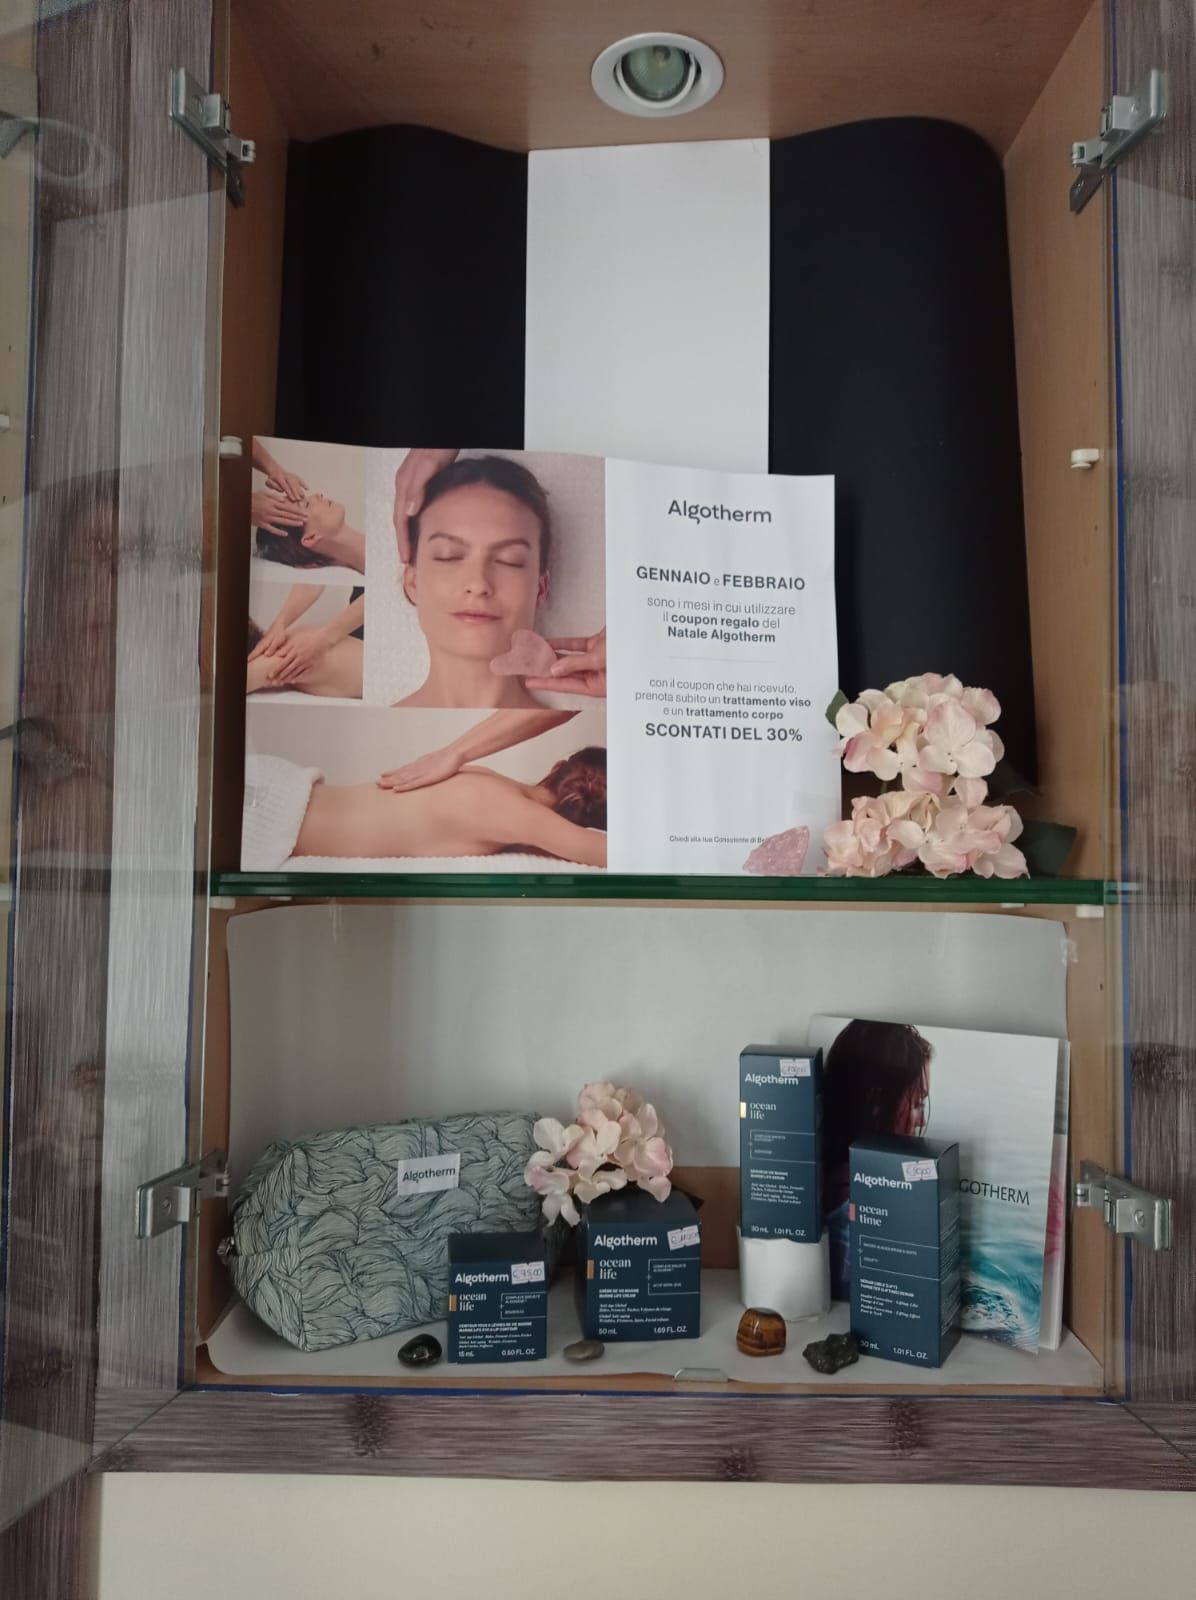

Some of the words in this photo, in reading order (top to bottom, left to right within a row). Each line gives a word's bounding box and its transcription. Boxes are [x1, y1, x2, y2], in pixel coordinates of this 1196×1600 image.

[668, 500, 772, 525] Algotherm
[636, 566, 711, 585] GENNAIO
[714, 578, 720, 586] e
[723, 574, 805, 591] FEBBRAIO
[647, 597, 675, 608] sono
[683, 599, 710, 611] mesi
[713, 601, 723, 612] in
[725, 602, 741, 613] cui
[744, 603, 796, 616] utilizzare
[663, 612, 668, 622] il
[671, 614, 718, 629] coupon
[721, 615, 760, 630] regalo
[762, 617, 780, 629] del
[668, 626, 708, 639] Natale
[711, 628, 776, 643] Algotherm
[649, 680, 668, 688] con
[677, 681, 714, 692] coupon
[716, 682, 734, 692] che
[736, 683, 752, 693] hai
[635, 692, 674, 703] prenota
[676, 693, 706, 704] subito
[708, 696, 720, 704] un
[722, 696, 786, 706] trattamento
[789, 698, 812, 707] viso
[663, 708, 670, 716] e
[672, 708, 684, 716] un
[686, 708, 749, 718] trattamento
[752, 711, 784, 721] corpo
[645, 722, 726, 740] SCONTATI
[731, 726, 762, 741] DEL
[767, 728, 803, 742] 30%
[744, 1073, 799, 1086] Algotherm
[750, 1102, 776, 1110] ocean
[750, 1110, 764, 1120] life
[402, 1168, 456, 1184] Algotherm
[854, 1172, 912, 1191] Algotherm
[860, 1205, 888, 1216] ocean
[860, 1214, 882, 1226] time
[594, 1234, 658, 1250] Algotherm
[600, 1258, 632, 1268] ocean
[454, 1272, 510, 1286] Algotherm
[600, 1268, 618, 1280] life
[459, 1292, 486, 1301] ocean
[459, 1301, 475, 1312] life
[676, 1325, 688, 1333] OZ.
[870, 1342, 880, 1350] mL
[893, 1347, 905, 1356] 1.01
[906, 1350, 915, 1358] FL.
[916, 1352, 928, 1360] OZ.
